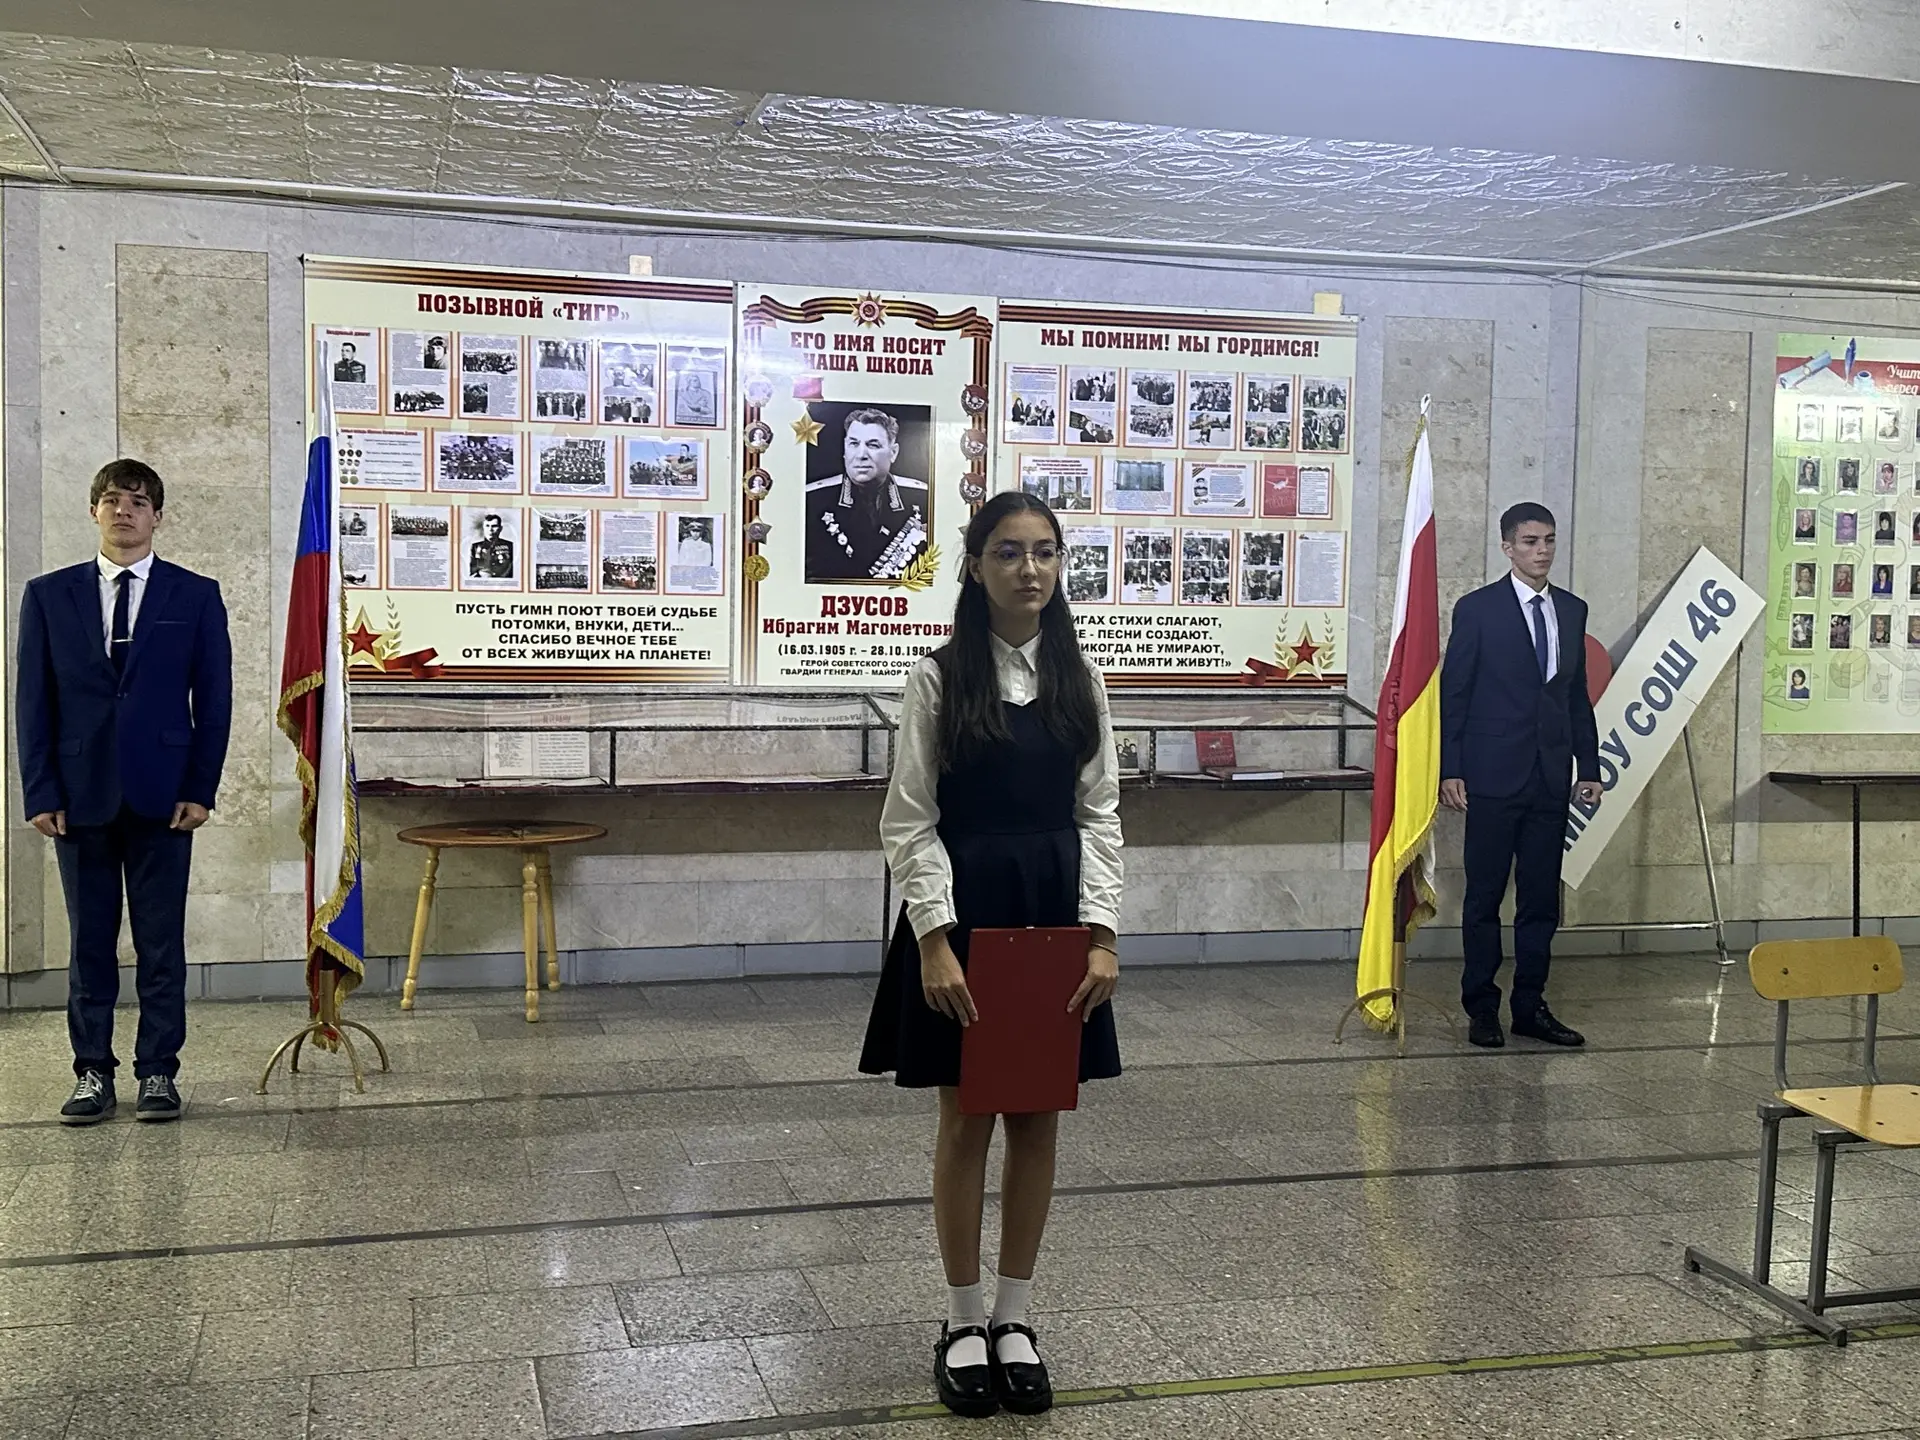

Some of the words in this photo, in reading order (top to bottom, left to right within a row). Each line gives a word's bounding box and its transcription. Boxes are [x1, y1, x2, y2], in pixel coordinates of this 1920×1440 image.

[418, 293, 544, 319] ПОЗЫВНОЙ
[552, 301, 631, 322] «ТИГР»
[791, 332, 826, 351] ЕГО
[834, 334, 875, 353] ИМЯ
[882, 336, 947, 356] НОСИТ
[1041, 328, 1075, 347] МЫ
[1081, 331, 1170, 352] ПОМНИМ!
[1177, 335, 1211, 353] МЫ
[1217, 336, 1320, 358] ГОРДИМСЯ!
[866, 357, 934, 376] ШКОЛА
[455, 604, 506, 616] ПУСТЬ
[510, 604, 553, 616] ГИМН
[557, 605, 604, 617] ПОЮТ
[606, 604, 657, 617] ТВОЕЙ
[660, 606, 718, 620] СУДЬБЕ
[820, 595, 909, 619] ДЗУСОВ
[491, 619, 571, 632] ПОТОМКИ,
[575, 620, 628, 633] ВНУКИ,
[632, 621, 684, 633] ДЕТИ...
[762, 618, 839, 638] Ибрагим
[1108, 615, 1153, 626] СТИХИ
[1156, 616, 1222, 629] СЛАГАЮТ,
[498, 633, 572, 645] СПАСИБО
[576, 635, 636, 646] ВЕЧНОЕ
[639, 635, 677, 646] ТЕБЕ
[1097, 629, 1142, 640] ПЕСНИ
[1145, 630, 1213, 642] СОЗДАЮТ.
[461, 647, 483, 659] ОТ
[487, 648, 528, 659] ВСЕХ
[531, 648, 611, 661] ЖИВУЩИХ
[614, 649, 636, 660] НА
[639, 650, 711, 661] ПЛАНЕТЕ!
[777, 643, 846, 657] (16.03.1905
[849, 647, 858, 656] г.
[1136, 643, 1154, 654] НЕ
[1156, 644, 1225, 657] УМИРАЮТ,
[800, 658, 830, 667] ГЕРОЙ
[831, 660, 889, 668] СОВЕТСКОГО
[1118, 657, 1173, 668] ПАМЯТИ
[1175, 657, 1232, 669] ЖИВУТ!»
[1625, 639, 1698, 736] СОШ
[1686, 579, 1737, 643] 46
[780, 668, 822, 677] ГВАРДИИ
[824, 668, 863, 677] ГЕНЕРАЛ
[871, 669, 903, 677] МАЙОР
